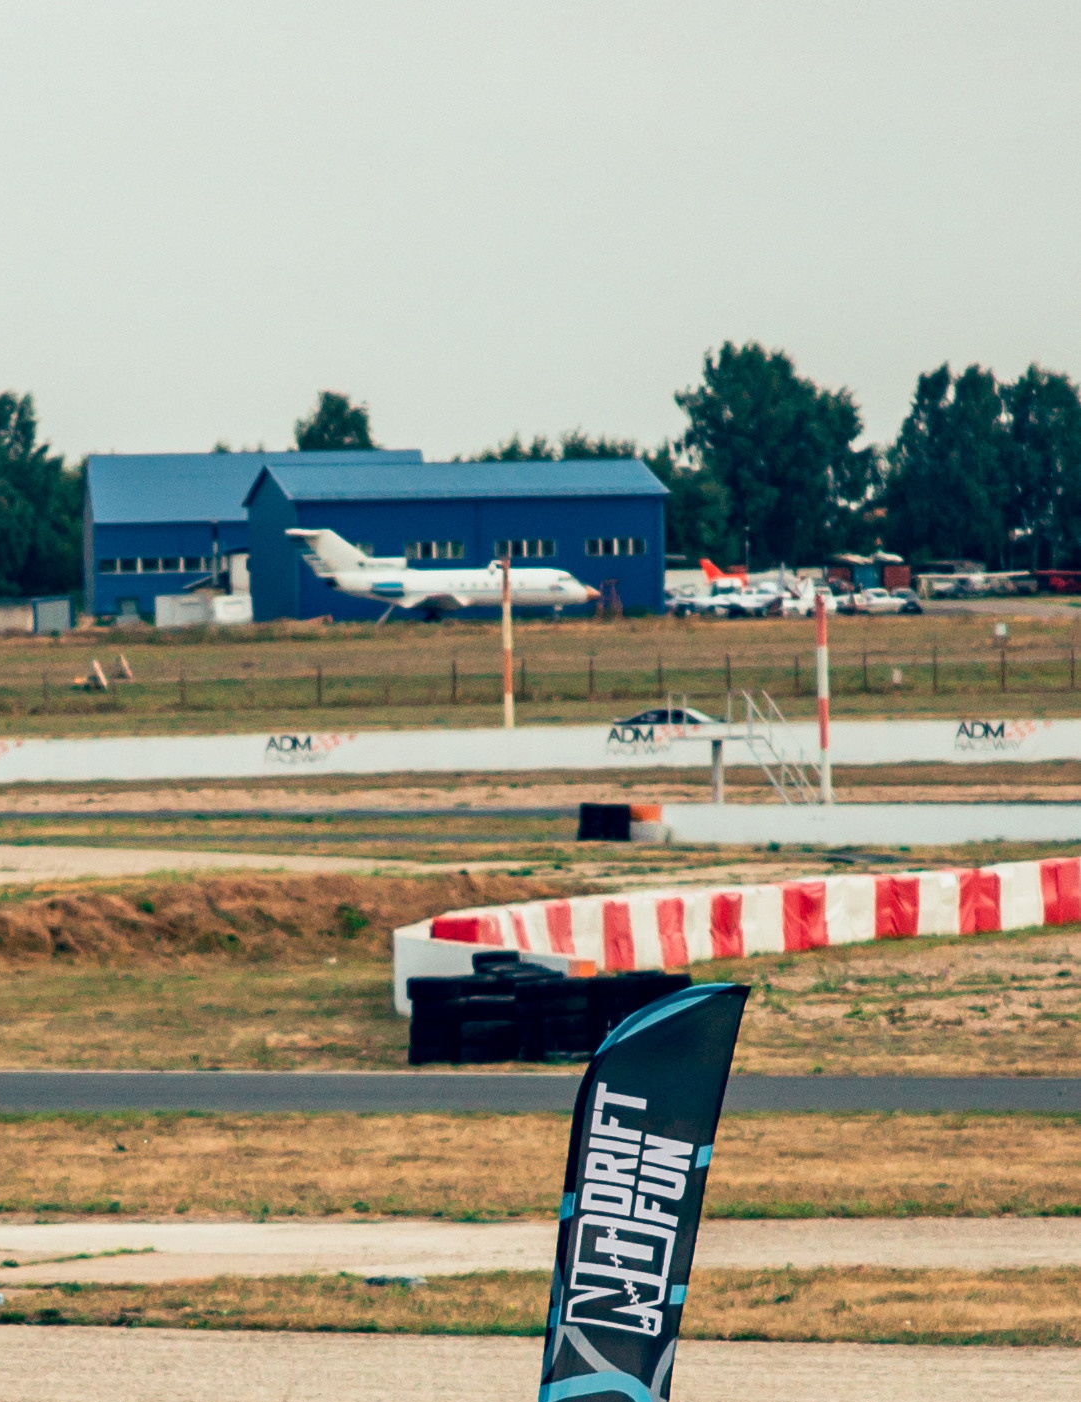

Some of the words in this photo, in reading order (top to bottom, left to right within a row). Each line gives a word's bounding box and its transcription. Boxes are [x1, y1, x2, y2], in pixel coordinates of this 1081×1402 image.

[607, 726, 655, 743] ADM
[957, 721, 1005, 738] ADM
[266, 736, 312, 752] ADM
[581, 1082, 648, 1217] DRIFT
[634, 1134, 694, 1228] FUN
